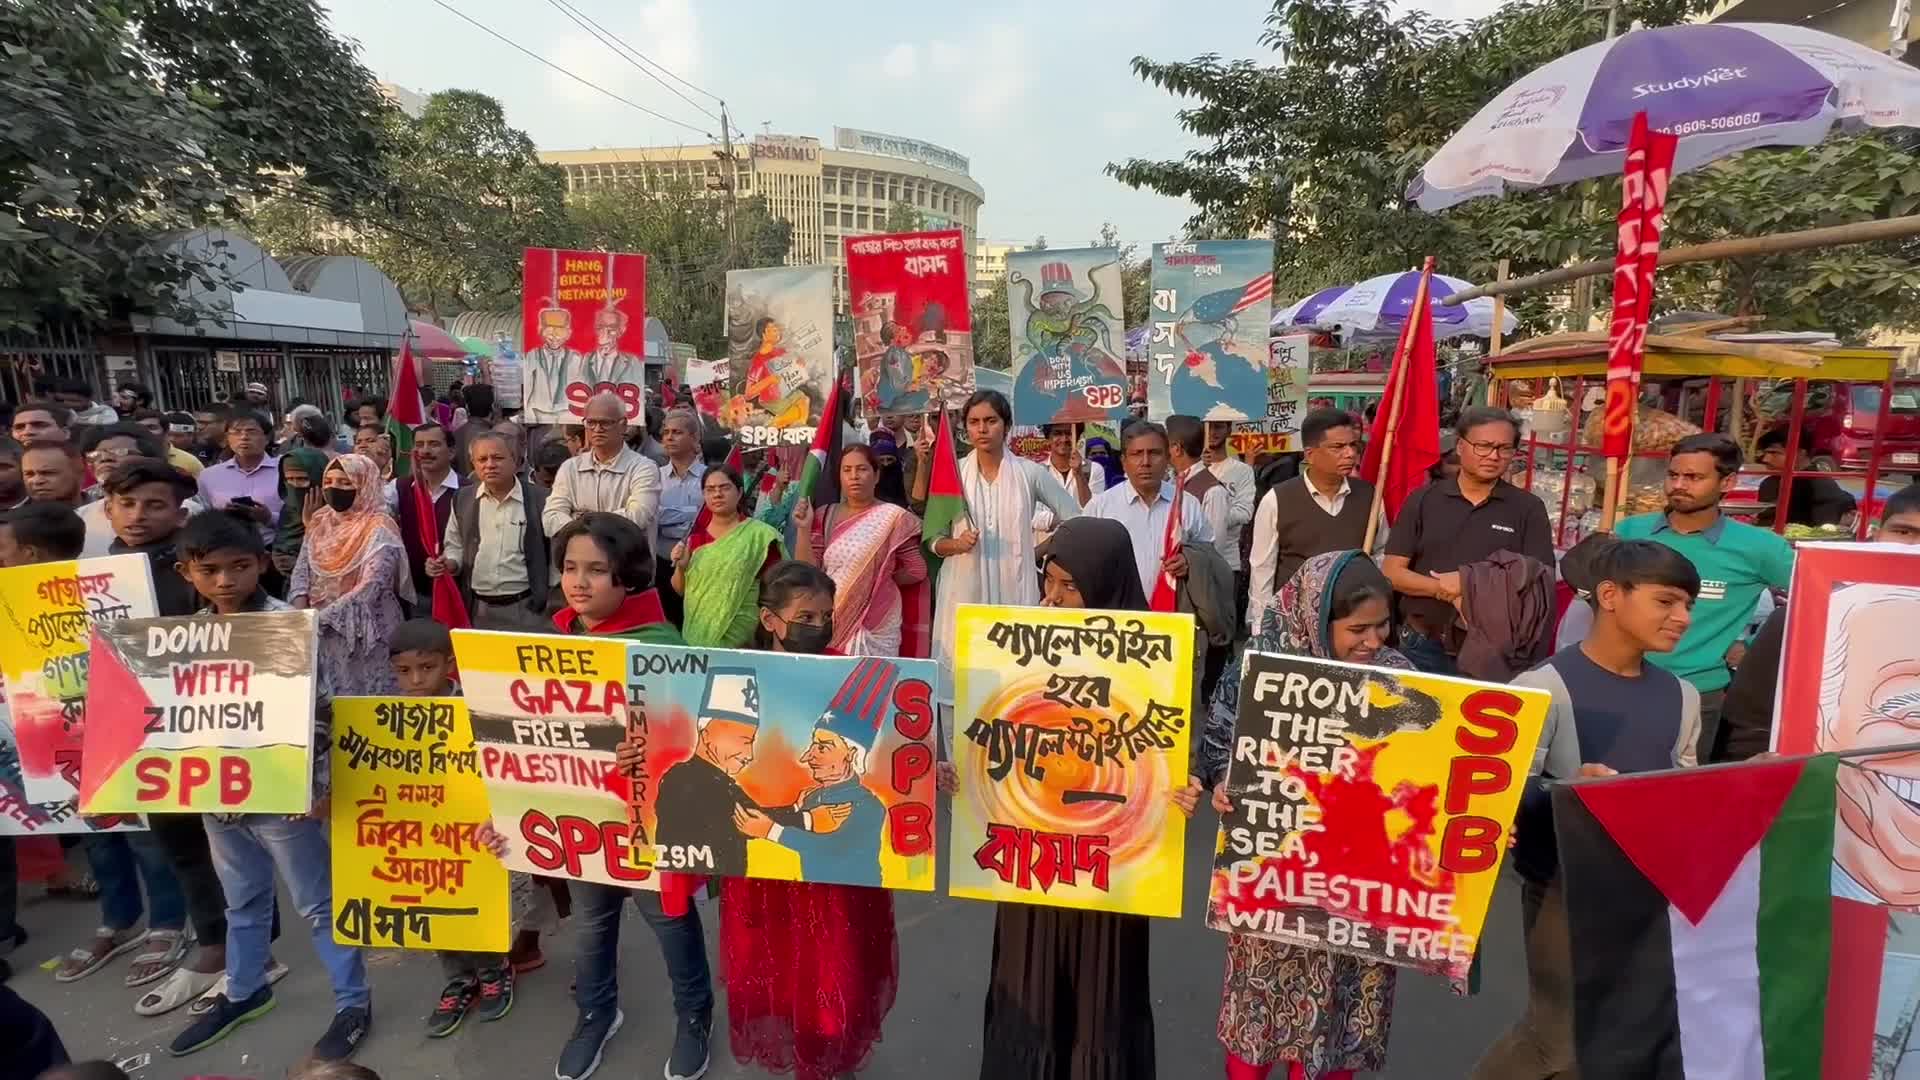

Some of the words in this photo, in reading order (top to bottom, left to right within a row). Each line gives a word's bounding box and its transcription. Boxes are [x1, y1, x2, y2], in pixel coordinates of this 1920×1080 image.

[1631, 67, 1748, 99] StudyNet
[1674, 112, 1761, 135] 9606-506060
[753, 143, 816, 161] BSMMU
[559, 274, 602, 287] BIDEN
[904, 254, 949, 278] বাসদ
[557, 287, 628, 301] NETANYAHU
[1051, 362, 1071, 371] WITH
[1084, 384, 1122, 408] SPB
[740, 425, 778, 446] SPB
[146, 621, 233, 657] DOWN
[988, 615, 1174, 669] প্যালেস্টাইন
[516, 644, 600, 677] FREE
[631, 653, 710, 677] DOWN
[170, 661, 252, 697] WITH
[1043, 673, 1111, 709] হবে
[1253, 671, 1371, 718] FROM
[509, 679, 629, 717] GAZA
[143, 700, 265, 735] ZIONISM
[374, 701, 455, 742] গাজায়
[513, 719, 591, 749] FREE
[1263, 710, 1350, 747] THE
[338, 726, 423, 777] মানবতার
[890, 678, 935, 857] SPB
[1235, 735, 1360, 782] RIVER
[135, 755, 253, 807] SPB
[357, 784, 389, 808] এ
[397, 785, 445, 806] সময়
[1253, 770, 1306, 801] TO
[1438, 689, 1524, 874] SPB
[356, 809, 423, 852] নিরব
[1241, 798, 1327, 833] THE
[973, 822, 1110, 892] বাসদ
[1230, 827, 1319, 867] SEA,
[372, 857, 472, 896] অন্যায়
[1228, 860, 1461, 925] PALESTINE
[335, 898, 478, 945] বাসদ
[1226, 902, 1319, 942] WILL
[1327, 917, 1372, 949] BE
[1385, 926, 1477, 963] FREE
